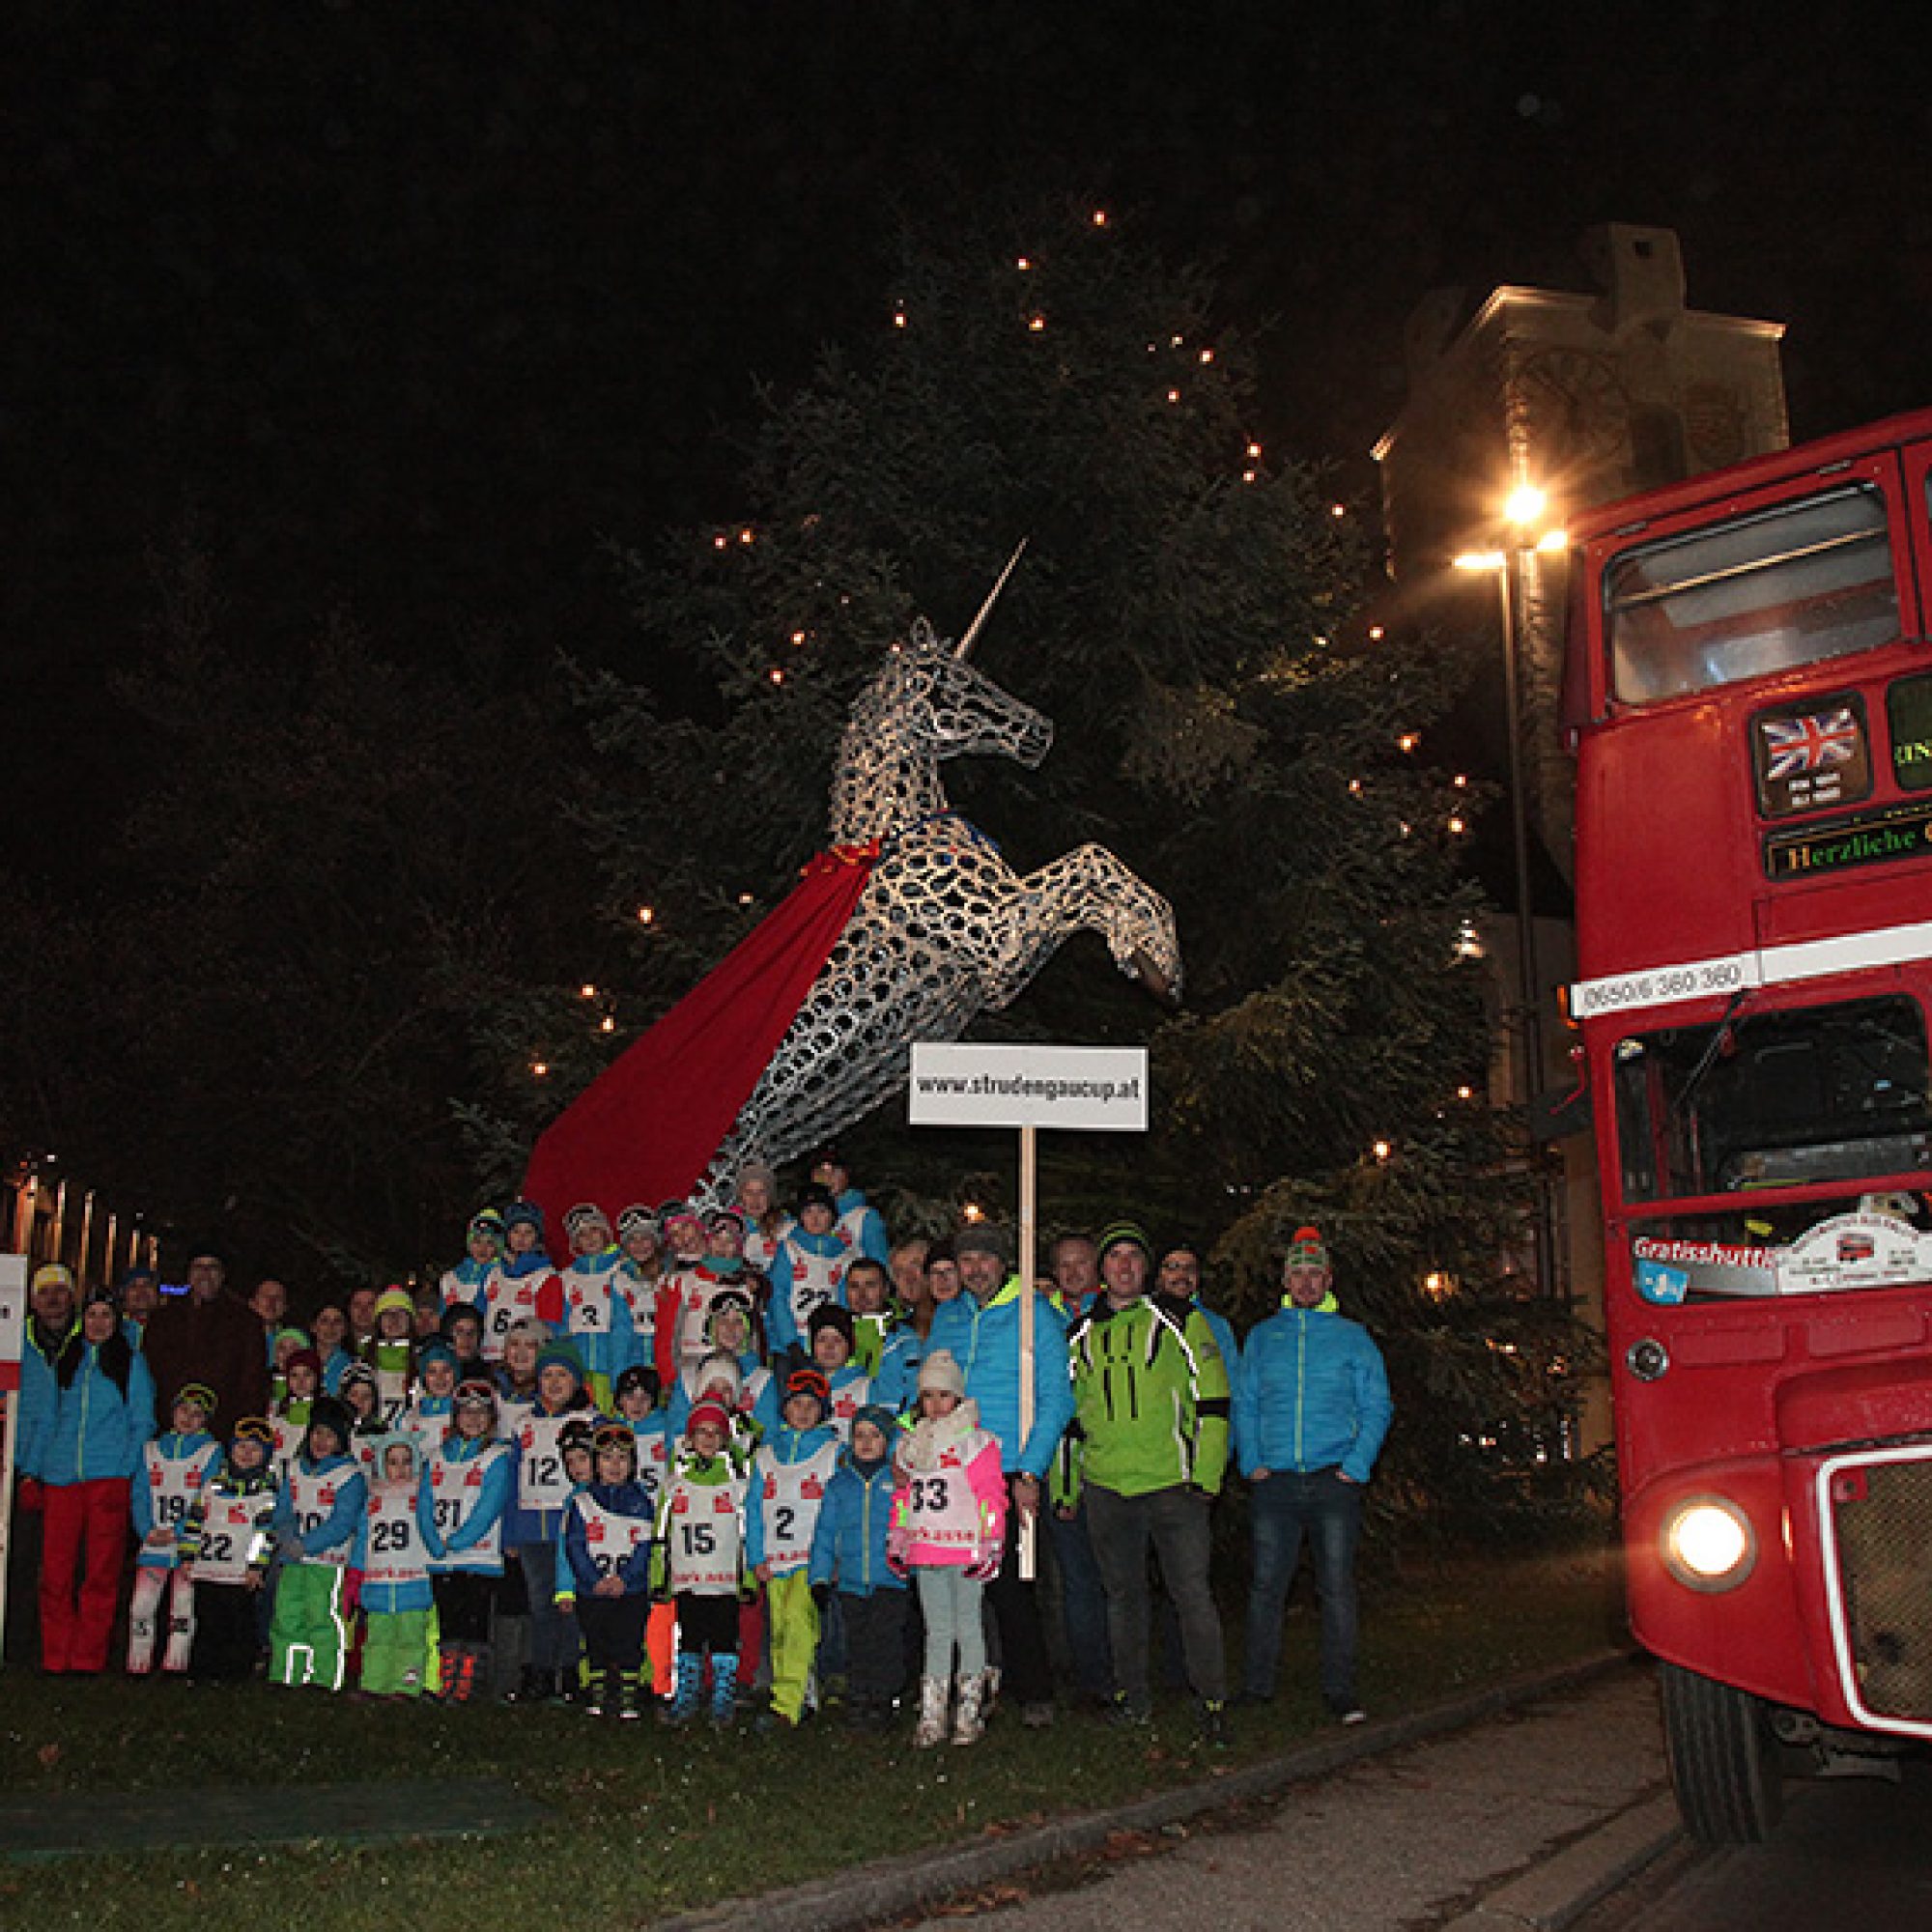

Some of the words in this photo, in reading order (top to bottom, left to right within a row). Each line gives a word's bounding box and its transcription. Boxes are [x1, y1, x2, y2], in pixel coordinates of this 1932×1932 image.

[1788, 831, 1916, 869] Herzliche
[1657, 970, 1697, 996] 360
[917, 1072, 1139, 1103] www.strudengaucup.at
[528, 1457, 559, 1487] 12
[159, 1495, 185, 1524] 19
[434, 1499, 461, 1527] 31
[775, 1506, 795, 1540] 2
[200, 1533, 232, 1561] 22
[373, 1519, 410, 1554] 29
[681, 1522, 716, 1557] 15
